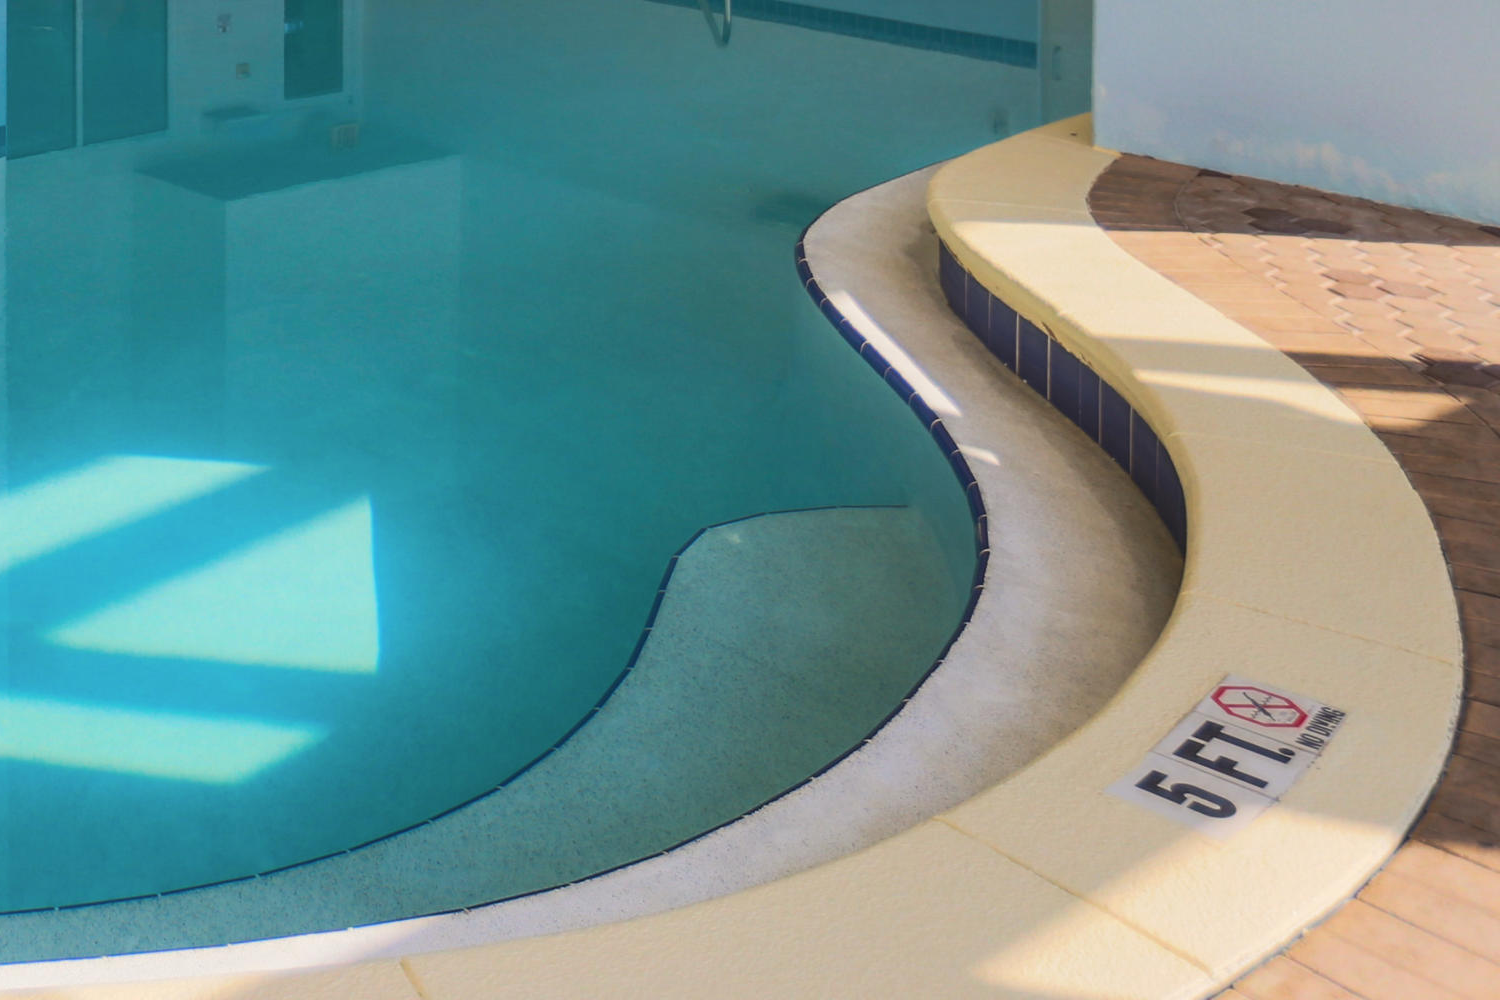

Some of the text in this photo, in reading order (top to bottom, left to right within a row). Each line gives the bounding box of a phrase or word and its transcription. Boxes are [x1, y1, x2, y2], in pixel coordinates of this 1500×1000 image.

[1296, 706, 1346, 749] NO DIVING
[1135, 720, 1296, 818] 5 FT.
